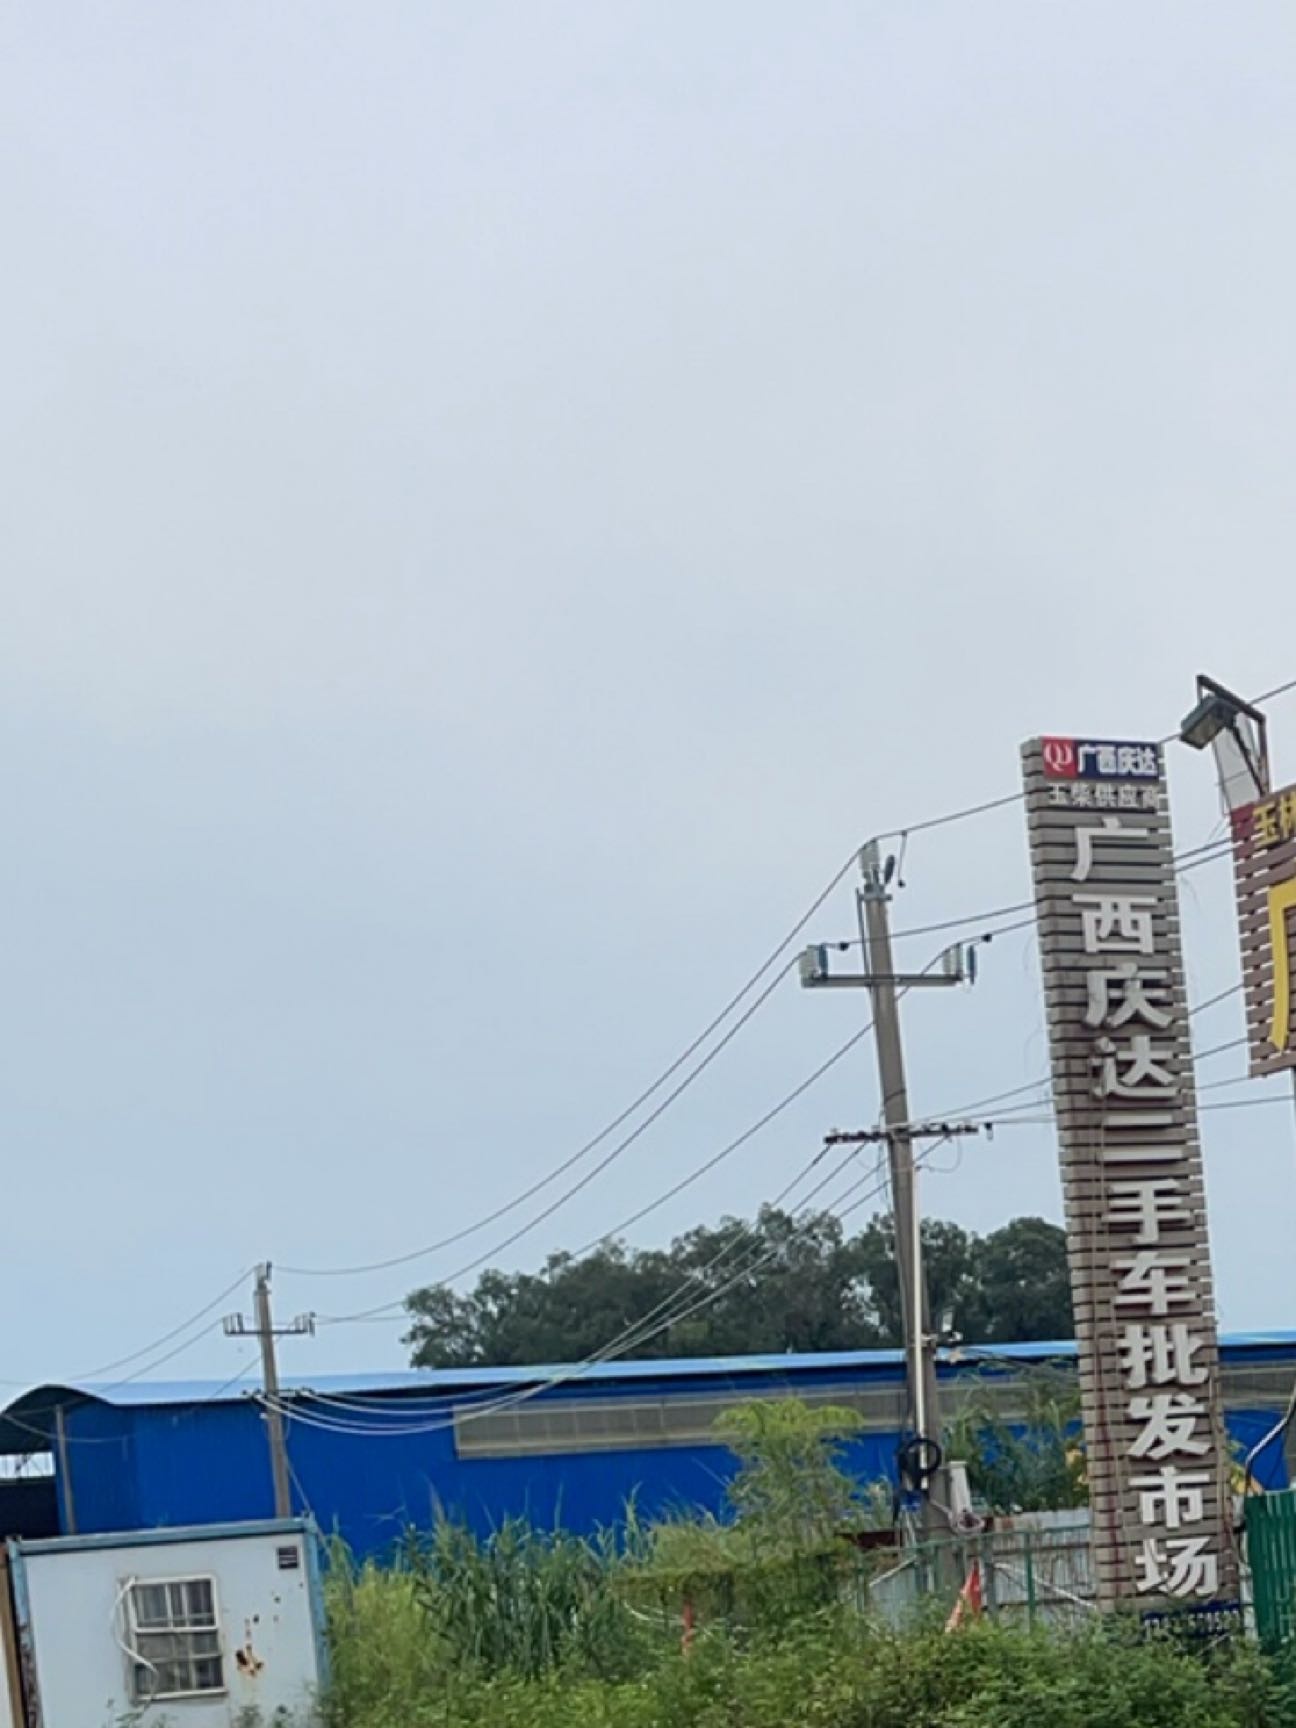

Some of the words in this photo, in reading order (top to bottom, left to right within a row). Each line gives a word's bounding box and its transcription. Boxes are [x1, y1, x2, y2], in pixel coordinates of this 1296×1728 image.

[1077, 744, 1158, 777] 广西庆达
[1071, 818, 1218, 1597] 广西庆达二手车批发市场
